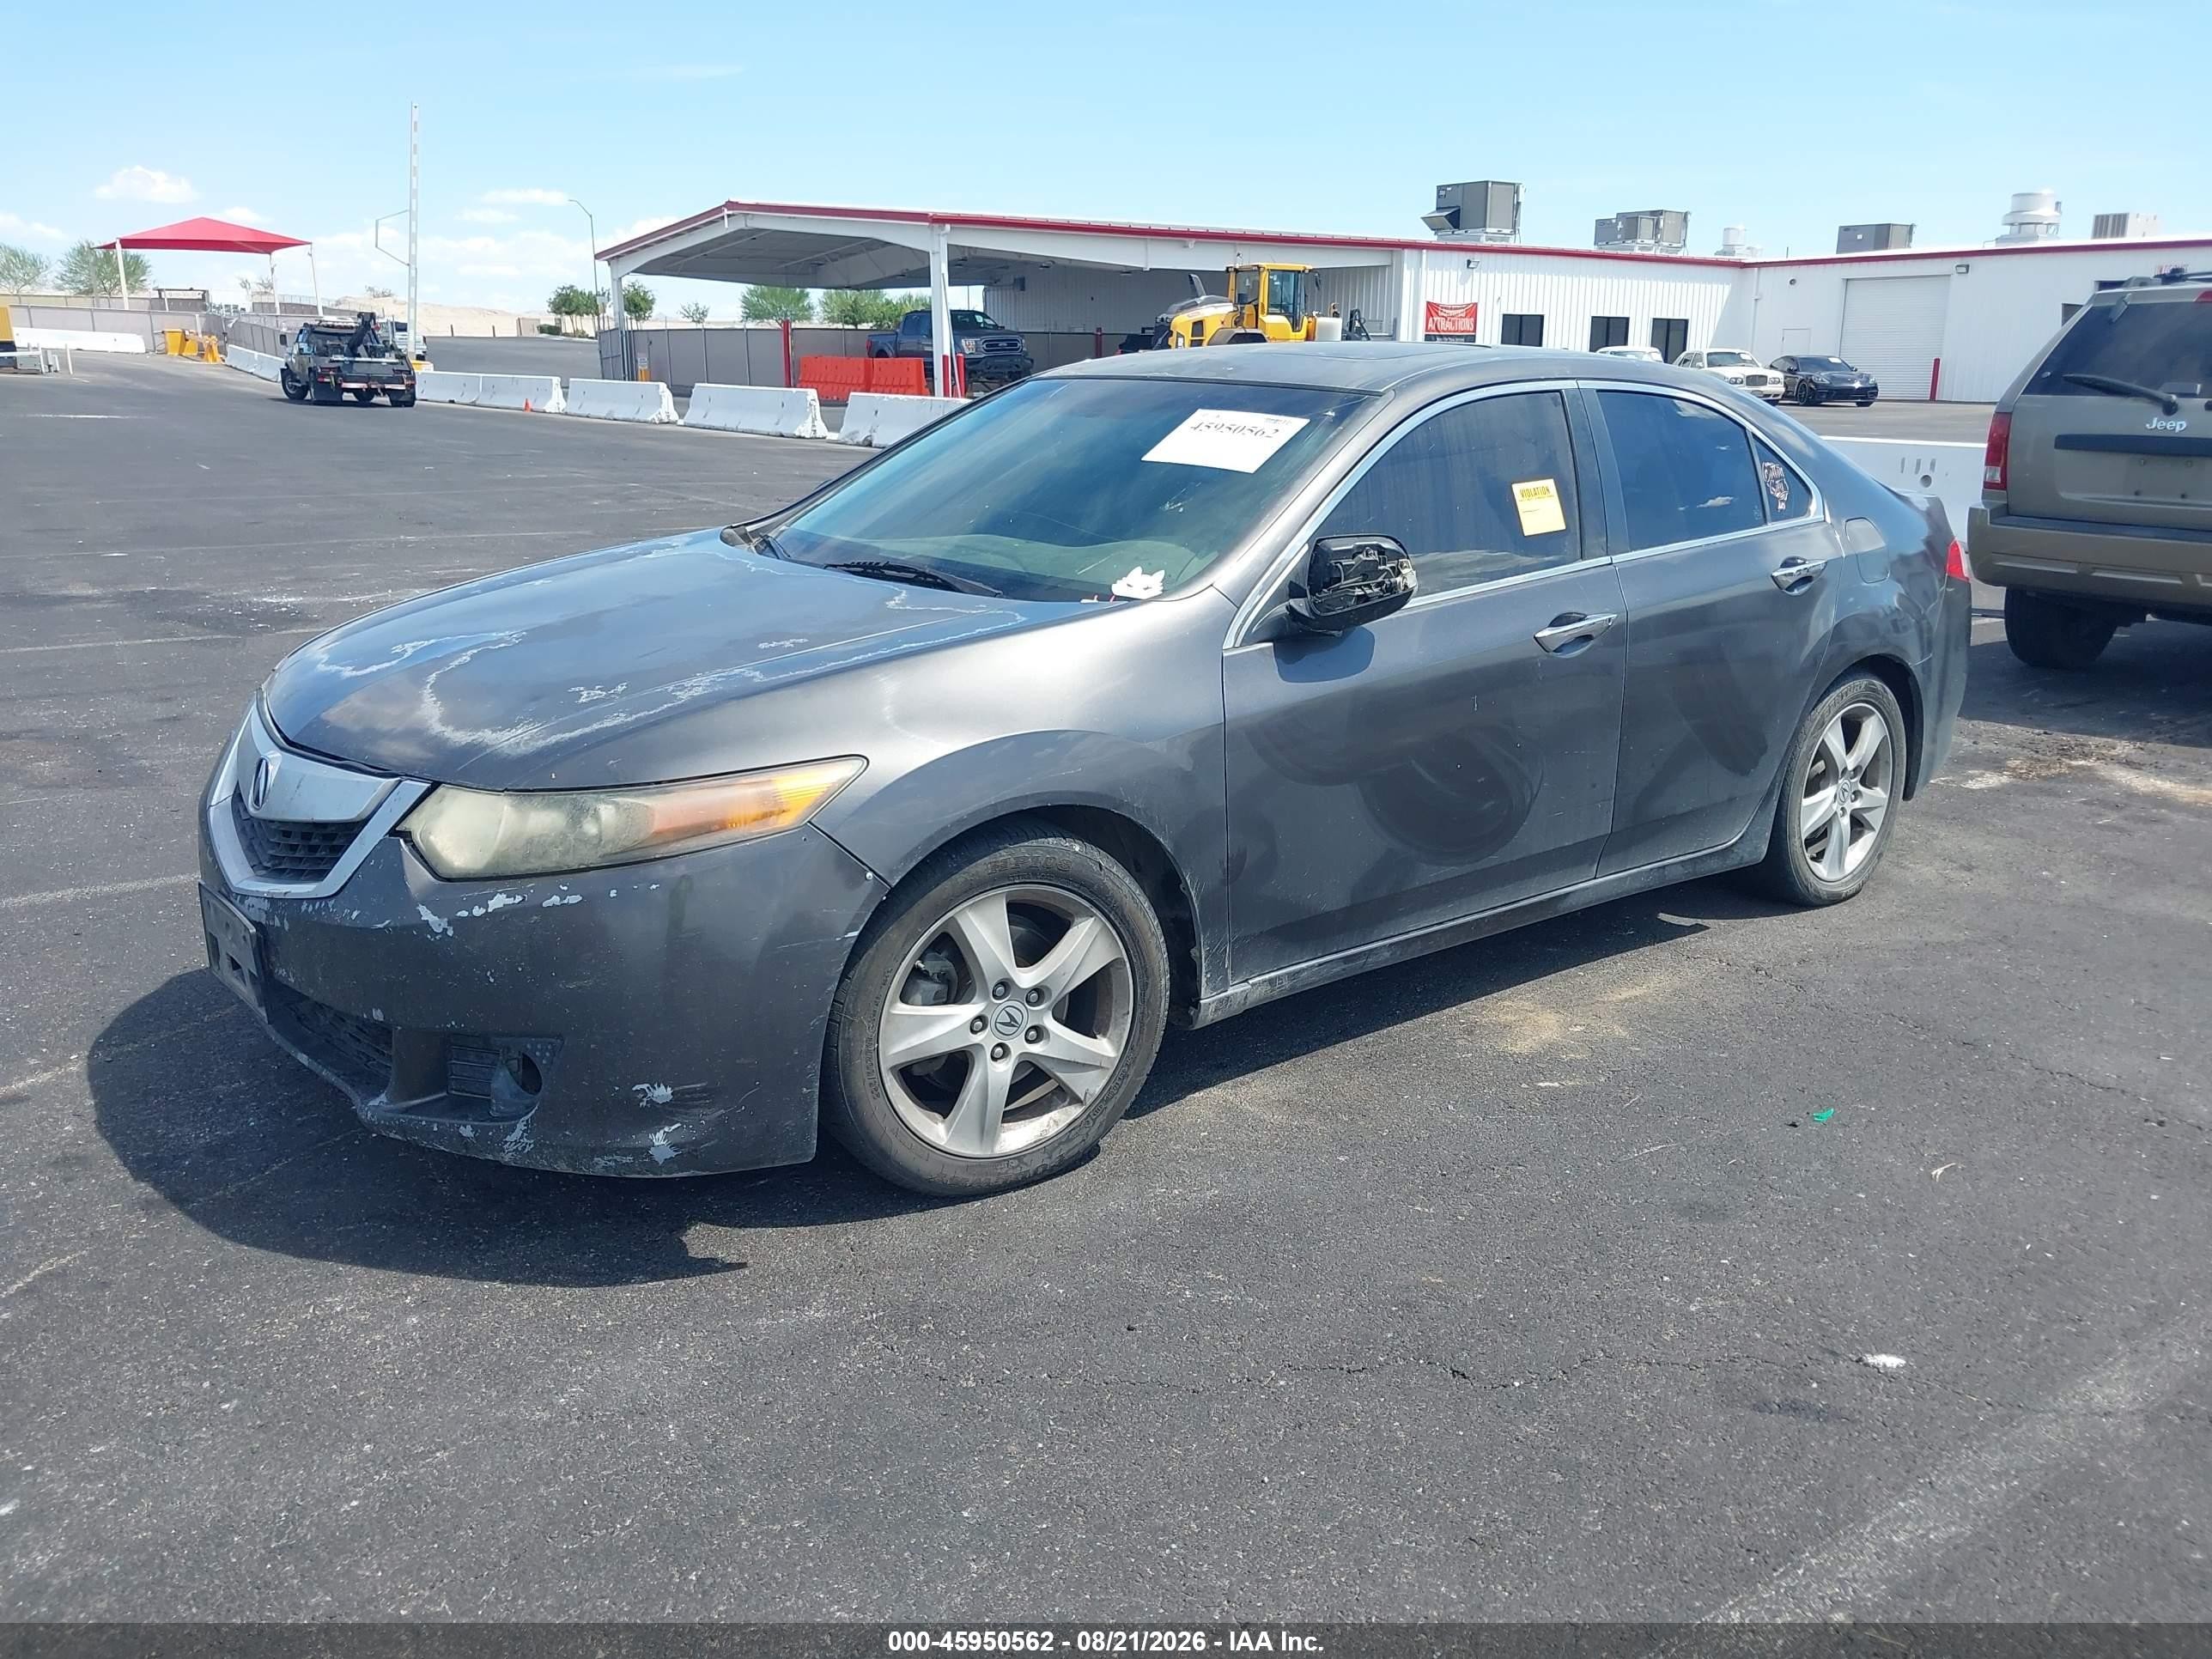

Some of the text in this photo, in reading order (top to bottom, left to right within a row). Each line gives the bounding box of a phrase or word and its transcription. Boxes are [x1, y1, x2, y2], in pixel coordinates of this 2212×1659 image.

[1428, 317, 1474, 331] ATTRACTIONS
[2146, 417, 2187, 433] Jeep
[1520, 485, 1551, 498] VIOLATION
